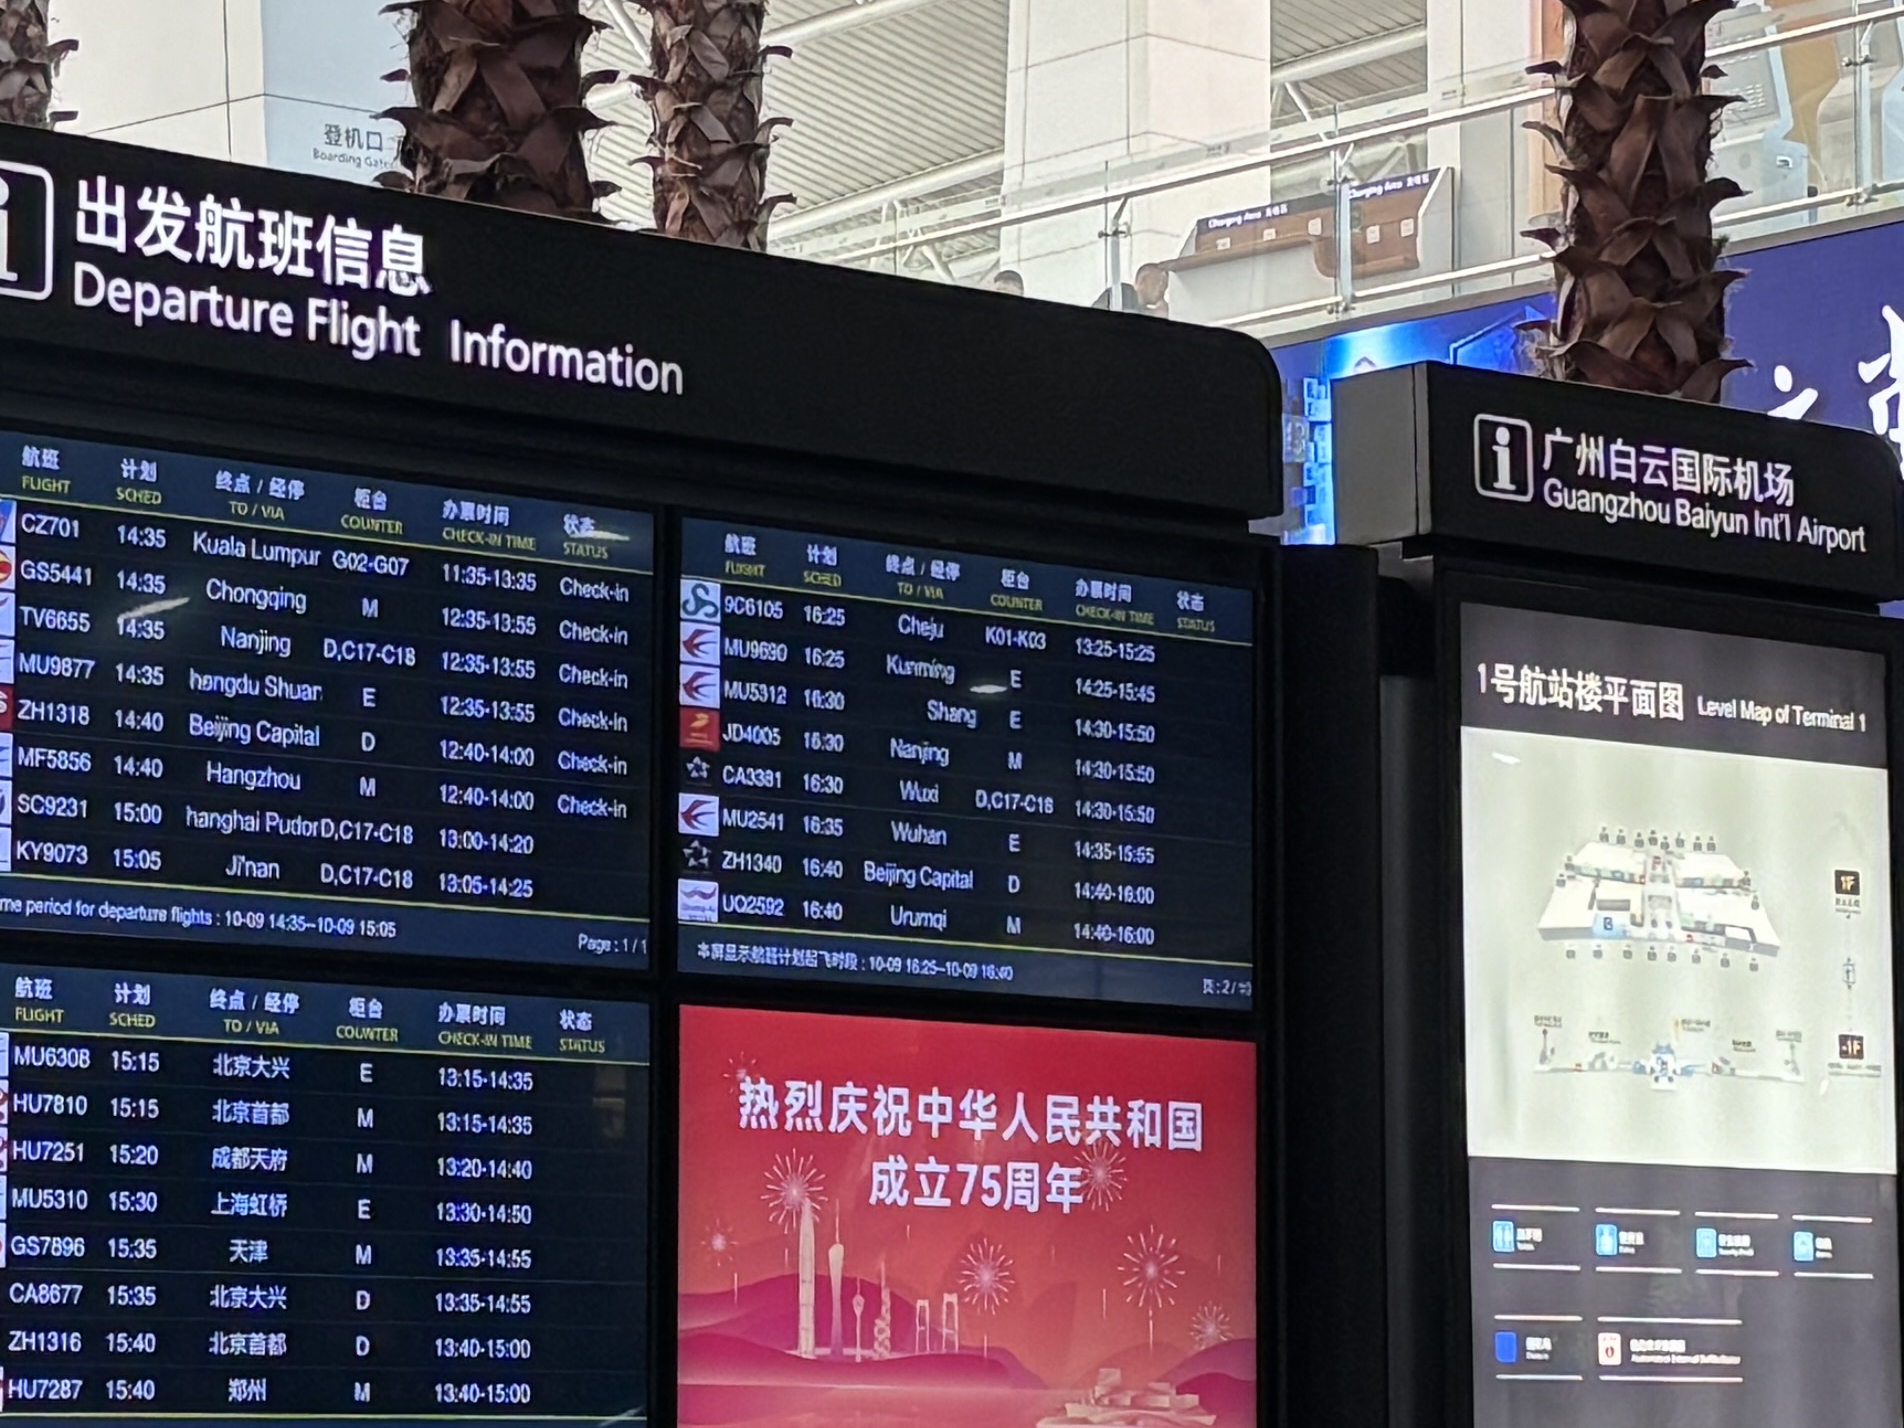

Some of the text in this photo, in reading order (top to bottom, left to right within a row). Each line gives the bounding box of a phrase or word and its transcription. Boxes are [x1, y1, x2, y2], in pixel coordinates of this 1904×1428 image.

[324, 123, 383, 153] 登机口
[312, 148, 361, 168] Boarding
[77, 176, 430, 297] 出发航班信息
[73, 262, 684, 397] Departure Flight Information
[1542, 427, 1795, 508] 广州白云国际机场
[22, 513, 79, 538] CZ701
[1543, 478, 1670, 526] Guangzhou
[1675, 497, 1749, 540] Baiyun
[1797, 516, 1867, 554] Airport
[21, 559, 91, 586] GS5441
[20, 606, 90, 632] TV6655
[897, 613, 944, 641] Cheju
[20, 653, 96, 679] MU9877
[1477, 662, 1685, 721] 1号航站楼平面图
[17, 699, 90, 726] ZH1318
[1697, 694, 1867, 732] Level Map of Terminal 1
[18, 747, 92, 772] MF5856
[890, 737, 949, 767] Nanjing
[900, 780, 939, 803] Wuxi
[18, 794, 87, 818] SC9231
[891, 820, 947, 845] Wuhan
[17, 840, 89, 865] KY9073
[890, 905, 947, 931] Urumqi
[15, 1045, 290, 1079] MU6308 北京大兴
[13, 1092, 290, 1125] HU7810 北京首都
[738, 1077, 1204, 1152] 热烈庆祝中华人民共和国
[13, 1140, 288, 1171] HU7251 成都天府
[869, 1155, 1086, 1214] 成立75周年
[12, 1188, 288, 1218] MU5310 上海虹桥
[11, 1235, 269, 1263] GS7896 天津
[9, 1282, 83, 1305] CA8677
[7, 1330, 82, 1352] ZH1316
[8, 1378, 83, 1400] HU7287
